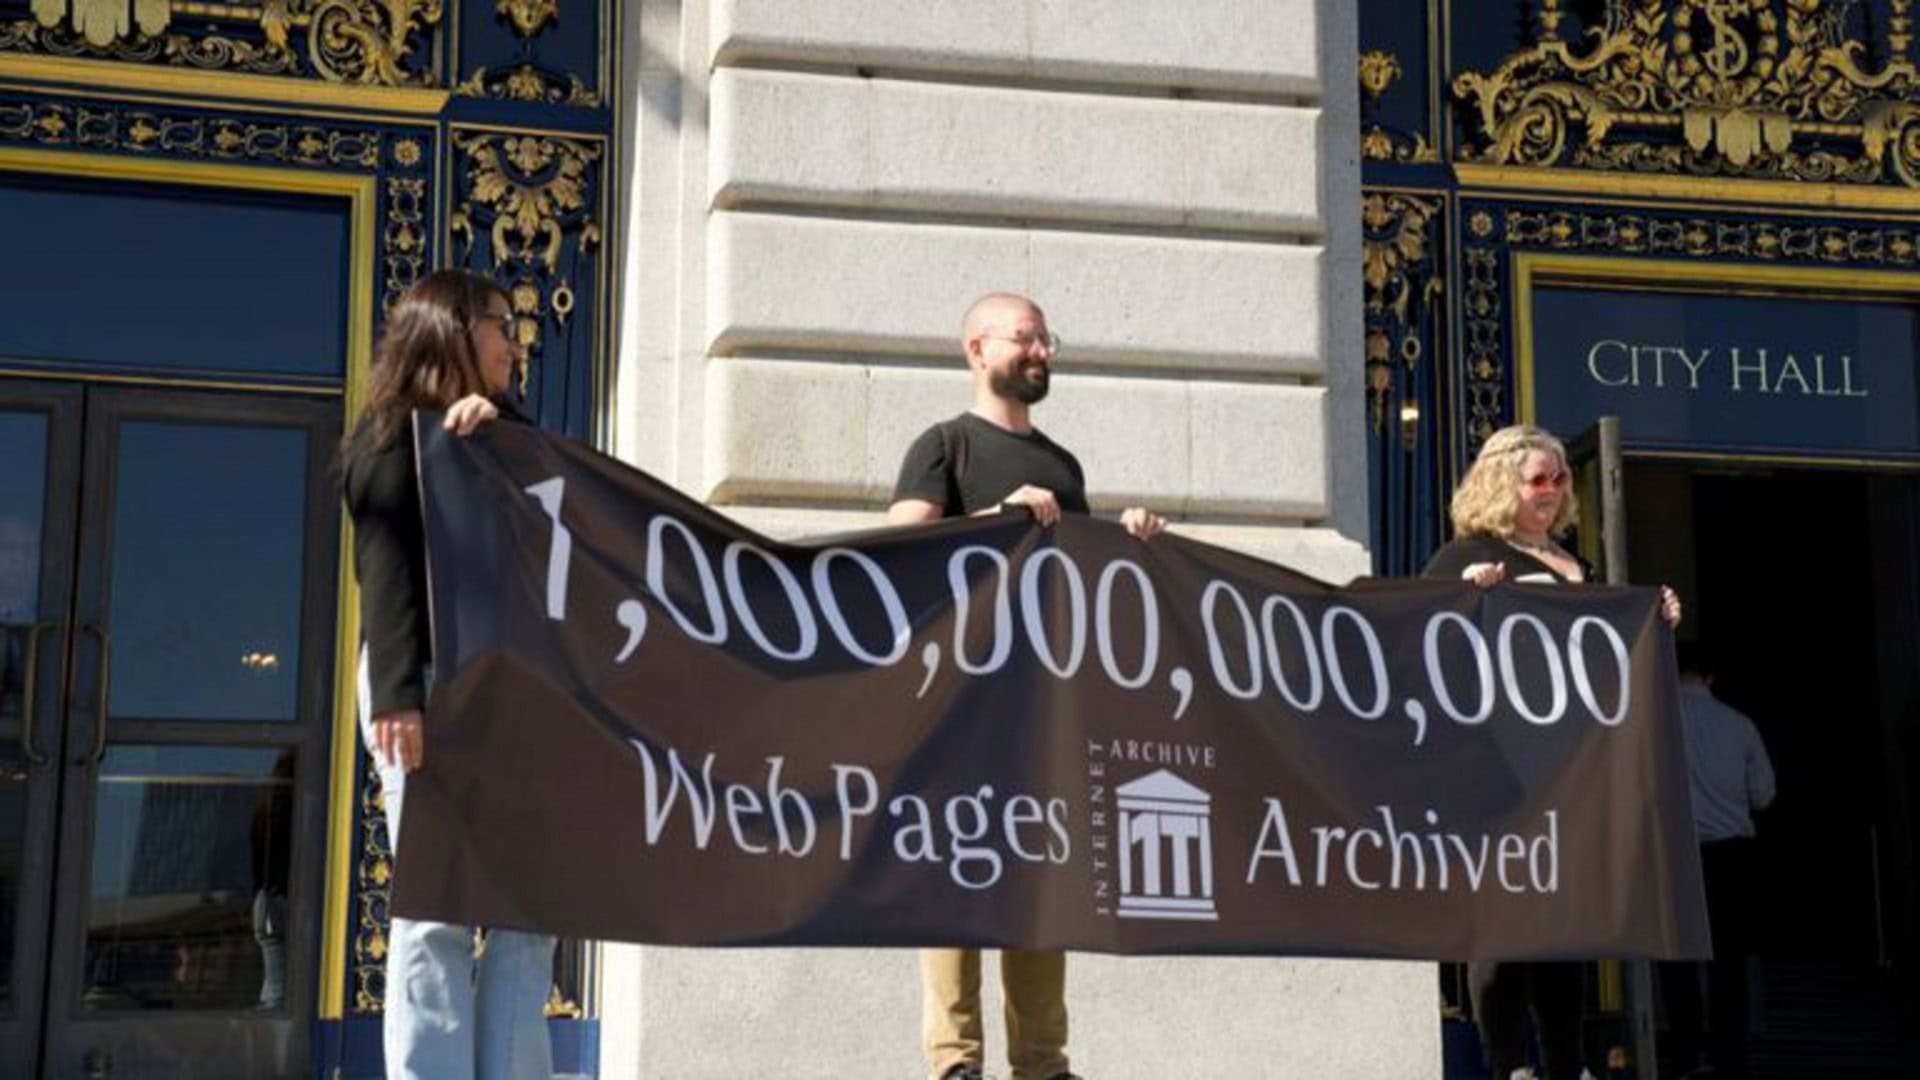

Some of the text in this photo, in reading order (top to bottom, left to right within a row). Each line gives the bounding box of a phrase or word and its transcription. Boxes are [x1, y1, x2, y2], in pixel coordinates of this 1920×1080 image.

[1587, 339, 1869, 396] CITY HALL
[524, 476, 1631, 746] 1,000,000,000,000
[630, 738, 1071, 889] Web Pages
[1110, 739, 1217, 768] ARCHIVE
[1088, 740, 1111, 915] INTERNET
[1246, 797, 1560, 892] Archived
